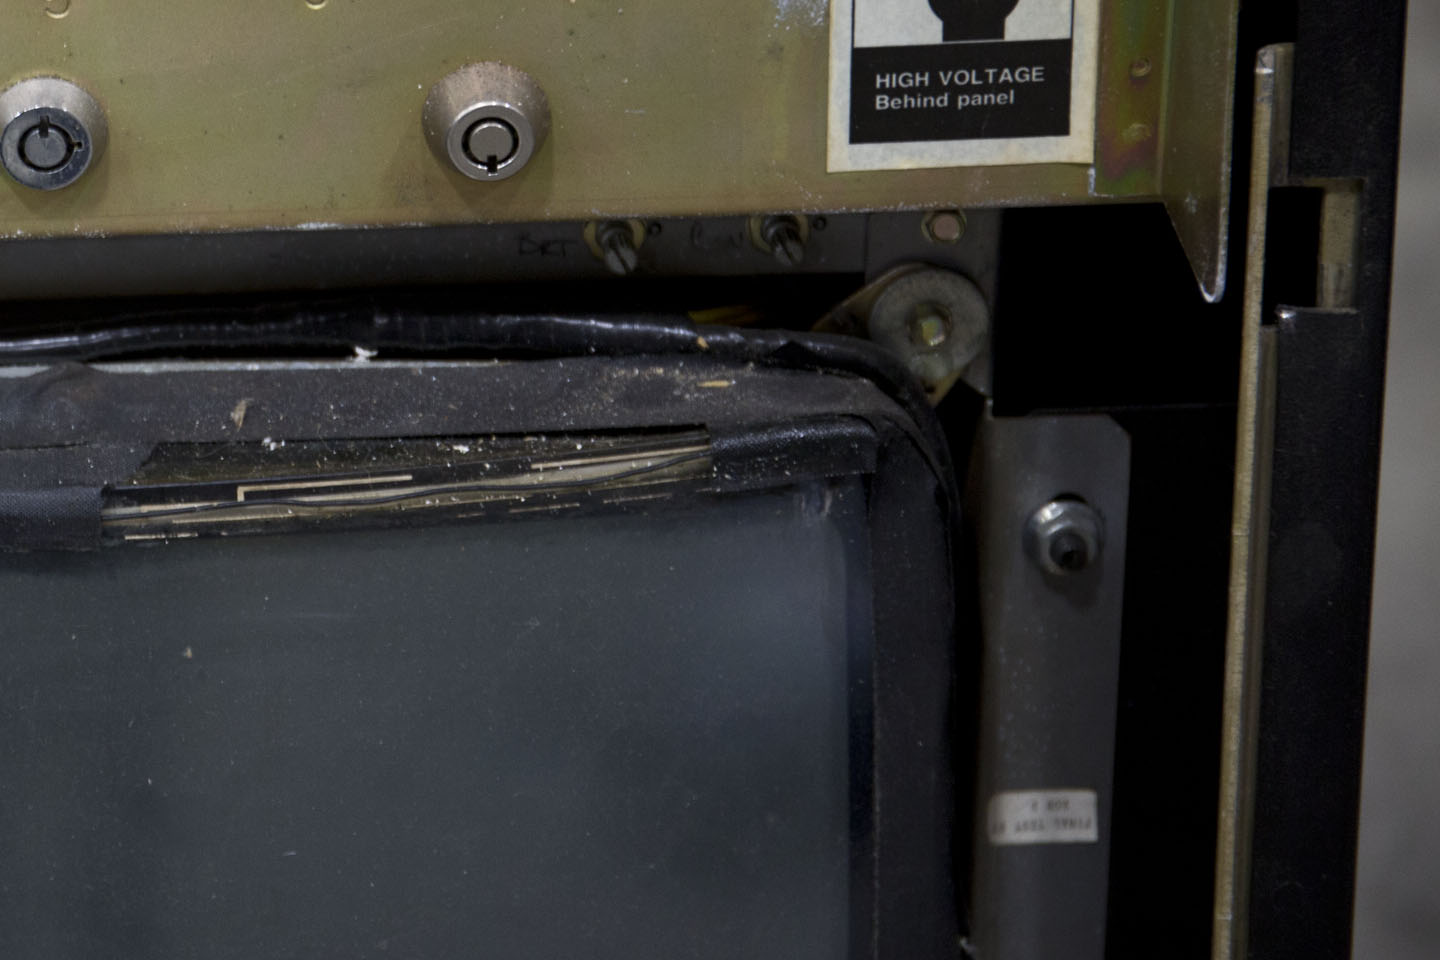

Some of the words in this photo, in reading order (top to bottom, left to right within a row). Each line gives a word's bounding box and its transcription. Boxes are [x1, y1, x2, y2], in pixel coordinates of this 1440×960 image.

[875, 71, 930, 90] HIGH
[938, 66, 1046, 87] VOLTAGE
[875, 92, 949, 111] Behind
[957, 90, 1015, 111] panel
